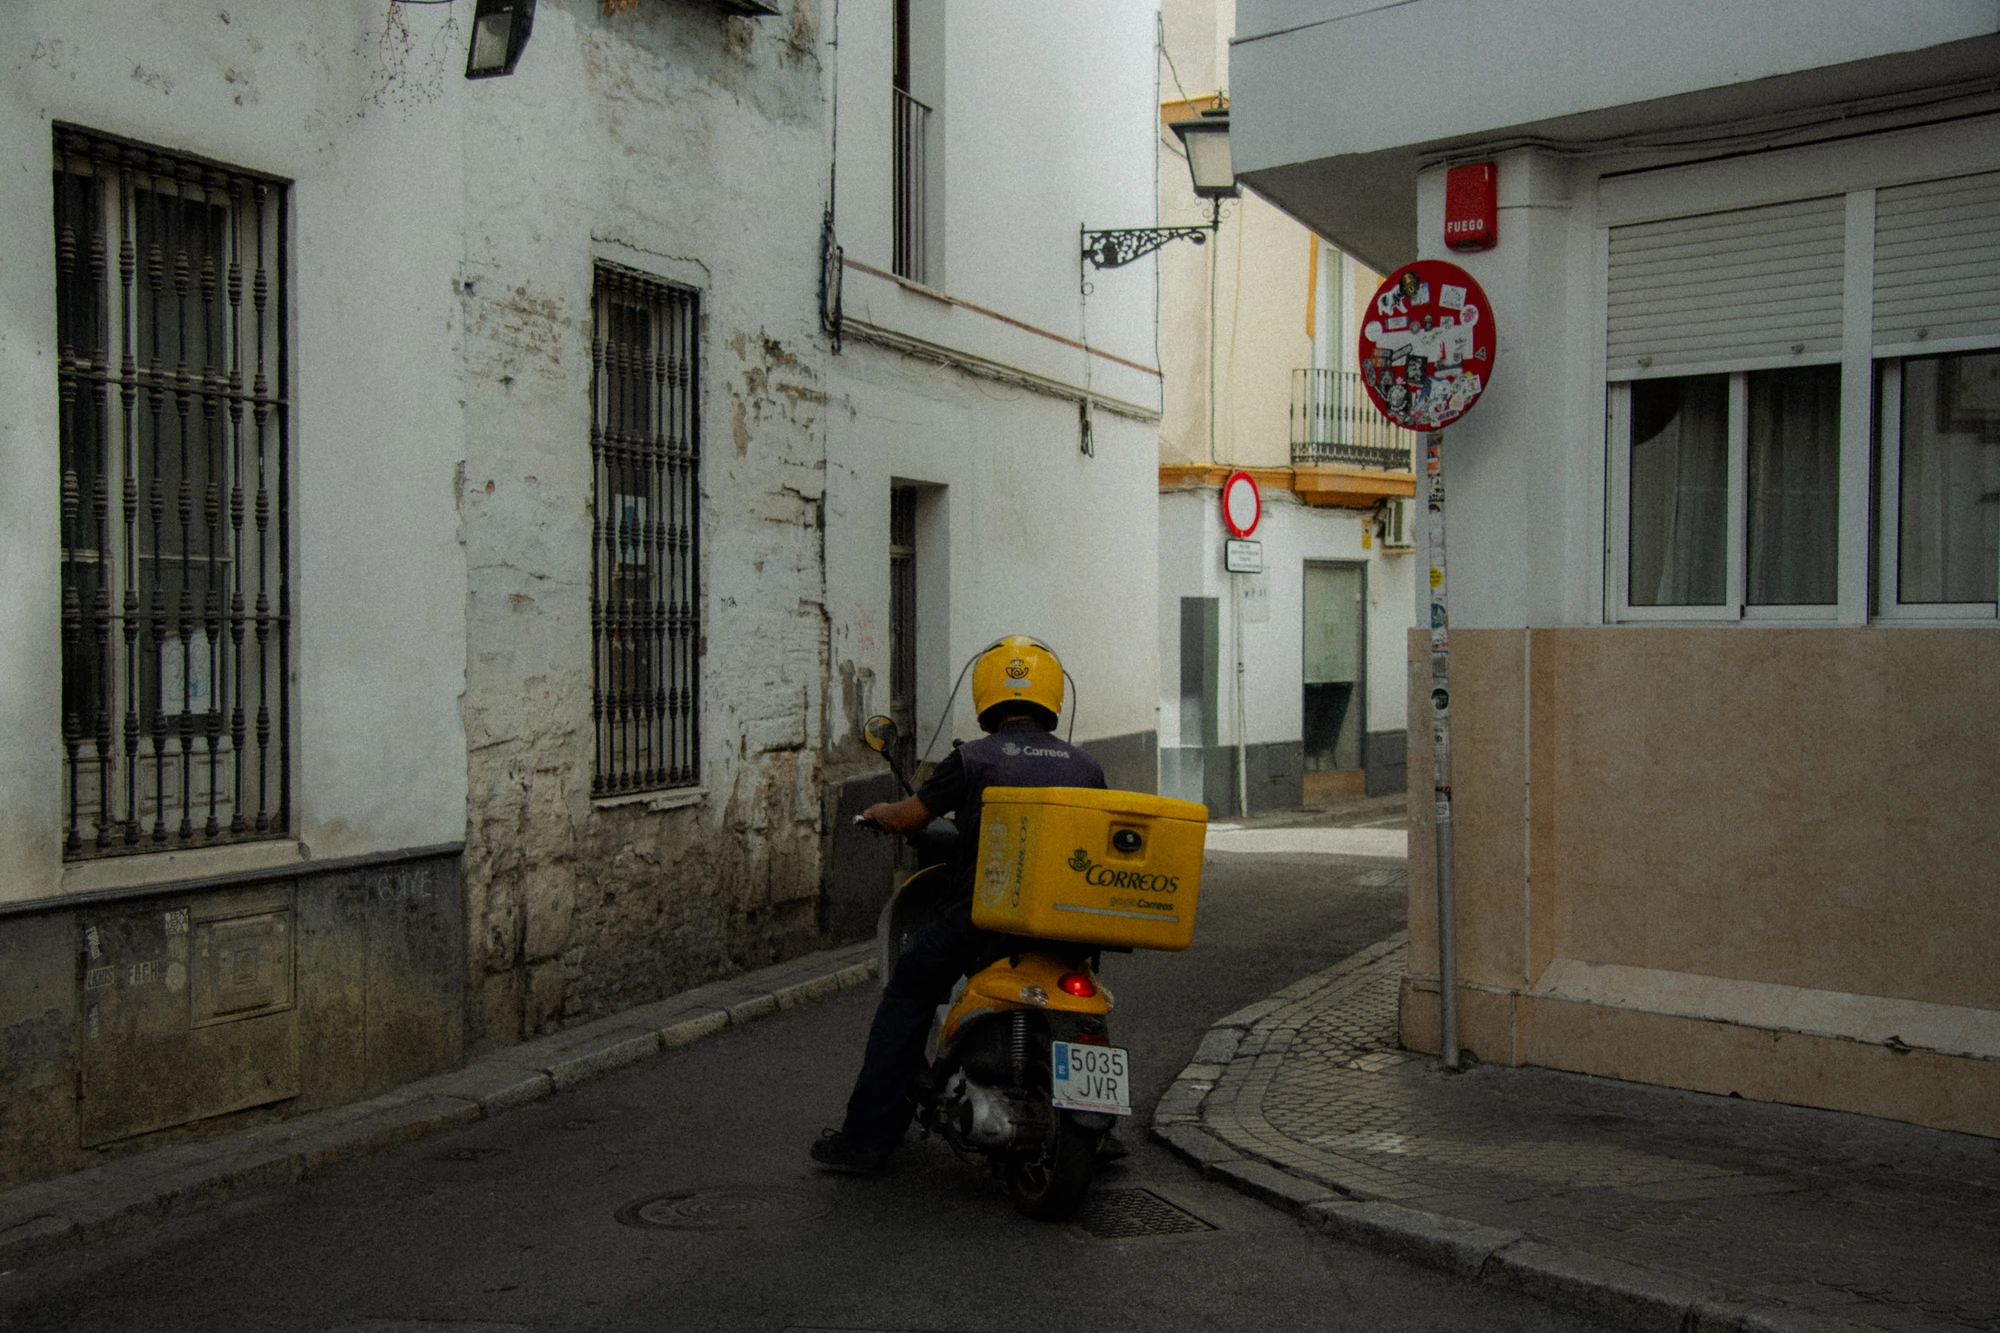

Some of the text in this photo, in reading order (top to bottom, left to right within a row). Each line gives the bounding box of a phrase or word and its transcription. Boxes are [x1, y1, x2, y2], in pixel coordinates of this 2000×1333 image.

[1447, 218, 1484, 233] FUEGO
[1023, 745, 1070, 759] Correos
[1085, 864, 1179, 893] CORREOS
[1137, 898, 1174, 911] Correos
[1071, 1049, 1123, 1076] 5035
[1079, 1075, 1118, 1100] JVR
